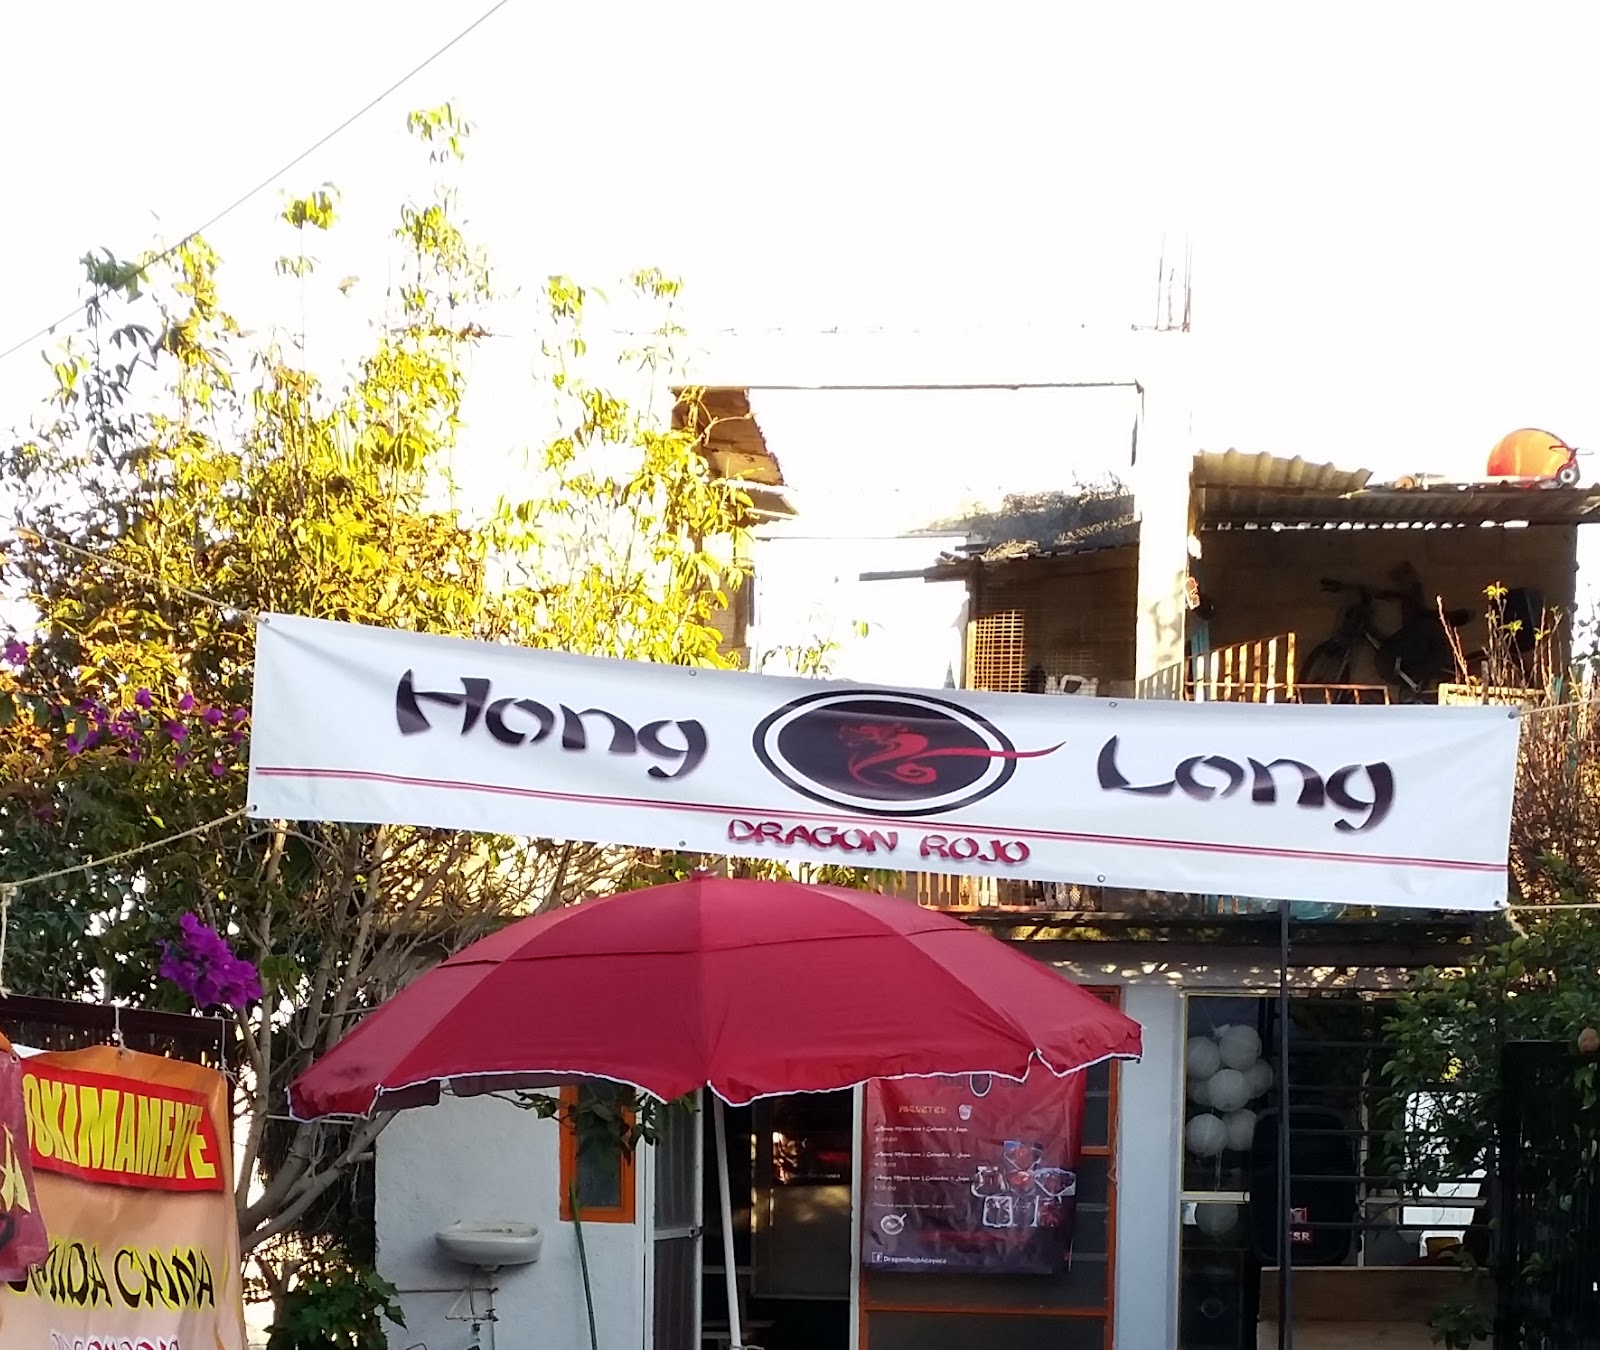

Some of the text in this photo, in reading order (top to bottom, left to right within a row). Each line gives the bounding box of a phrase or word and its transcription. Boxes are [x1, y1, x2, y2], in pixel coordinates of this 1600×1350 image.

[396, 668, 1395, 834] Hong Long
[727, 818, 1031, 865] DRAGON ROJO
[1289, 1231, 1310, 1241] SR
[114, 1248, 216, 1310] CHINA
